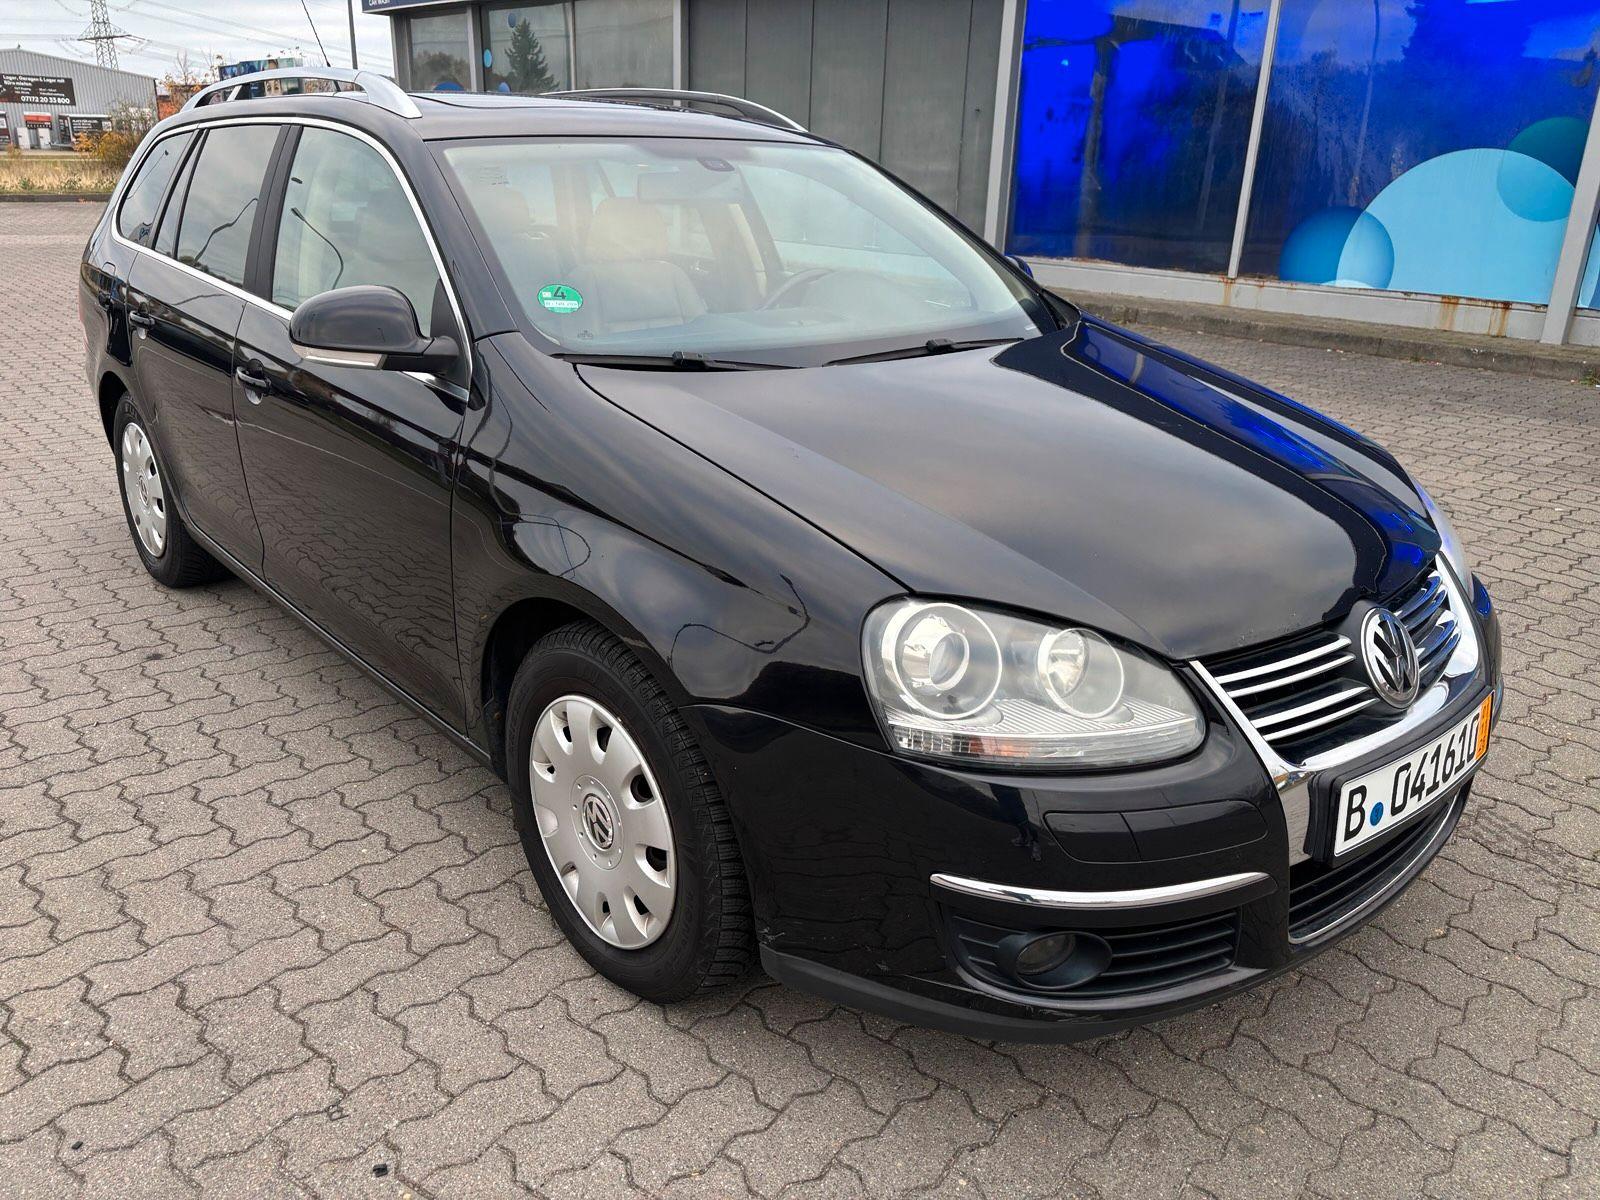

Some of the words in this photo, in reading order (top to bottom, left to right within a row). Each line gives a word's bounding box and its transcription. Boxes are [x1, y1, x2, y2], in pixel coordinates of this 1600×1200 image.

[554, 286, 567, 300] 4
[1344, 785, 1367, 842] B
[1391, 712, 1480, 816] 041610
